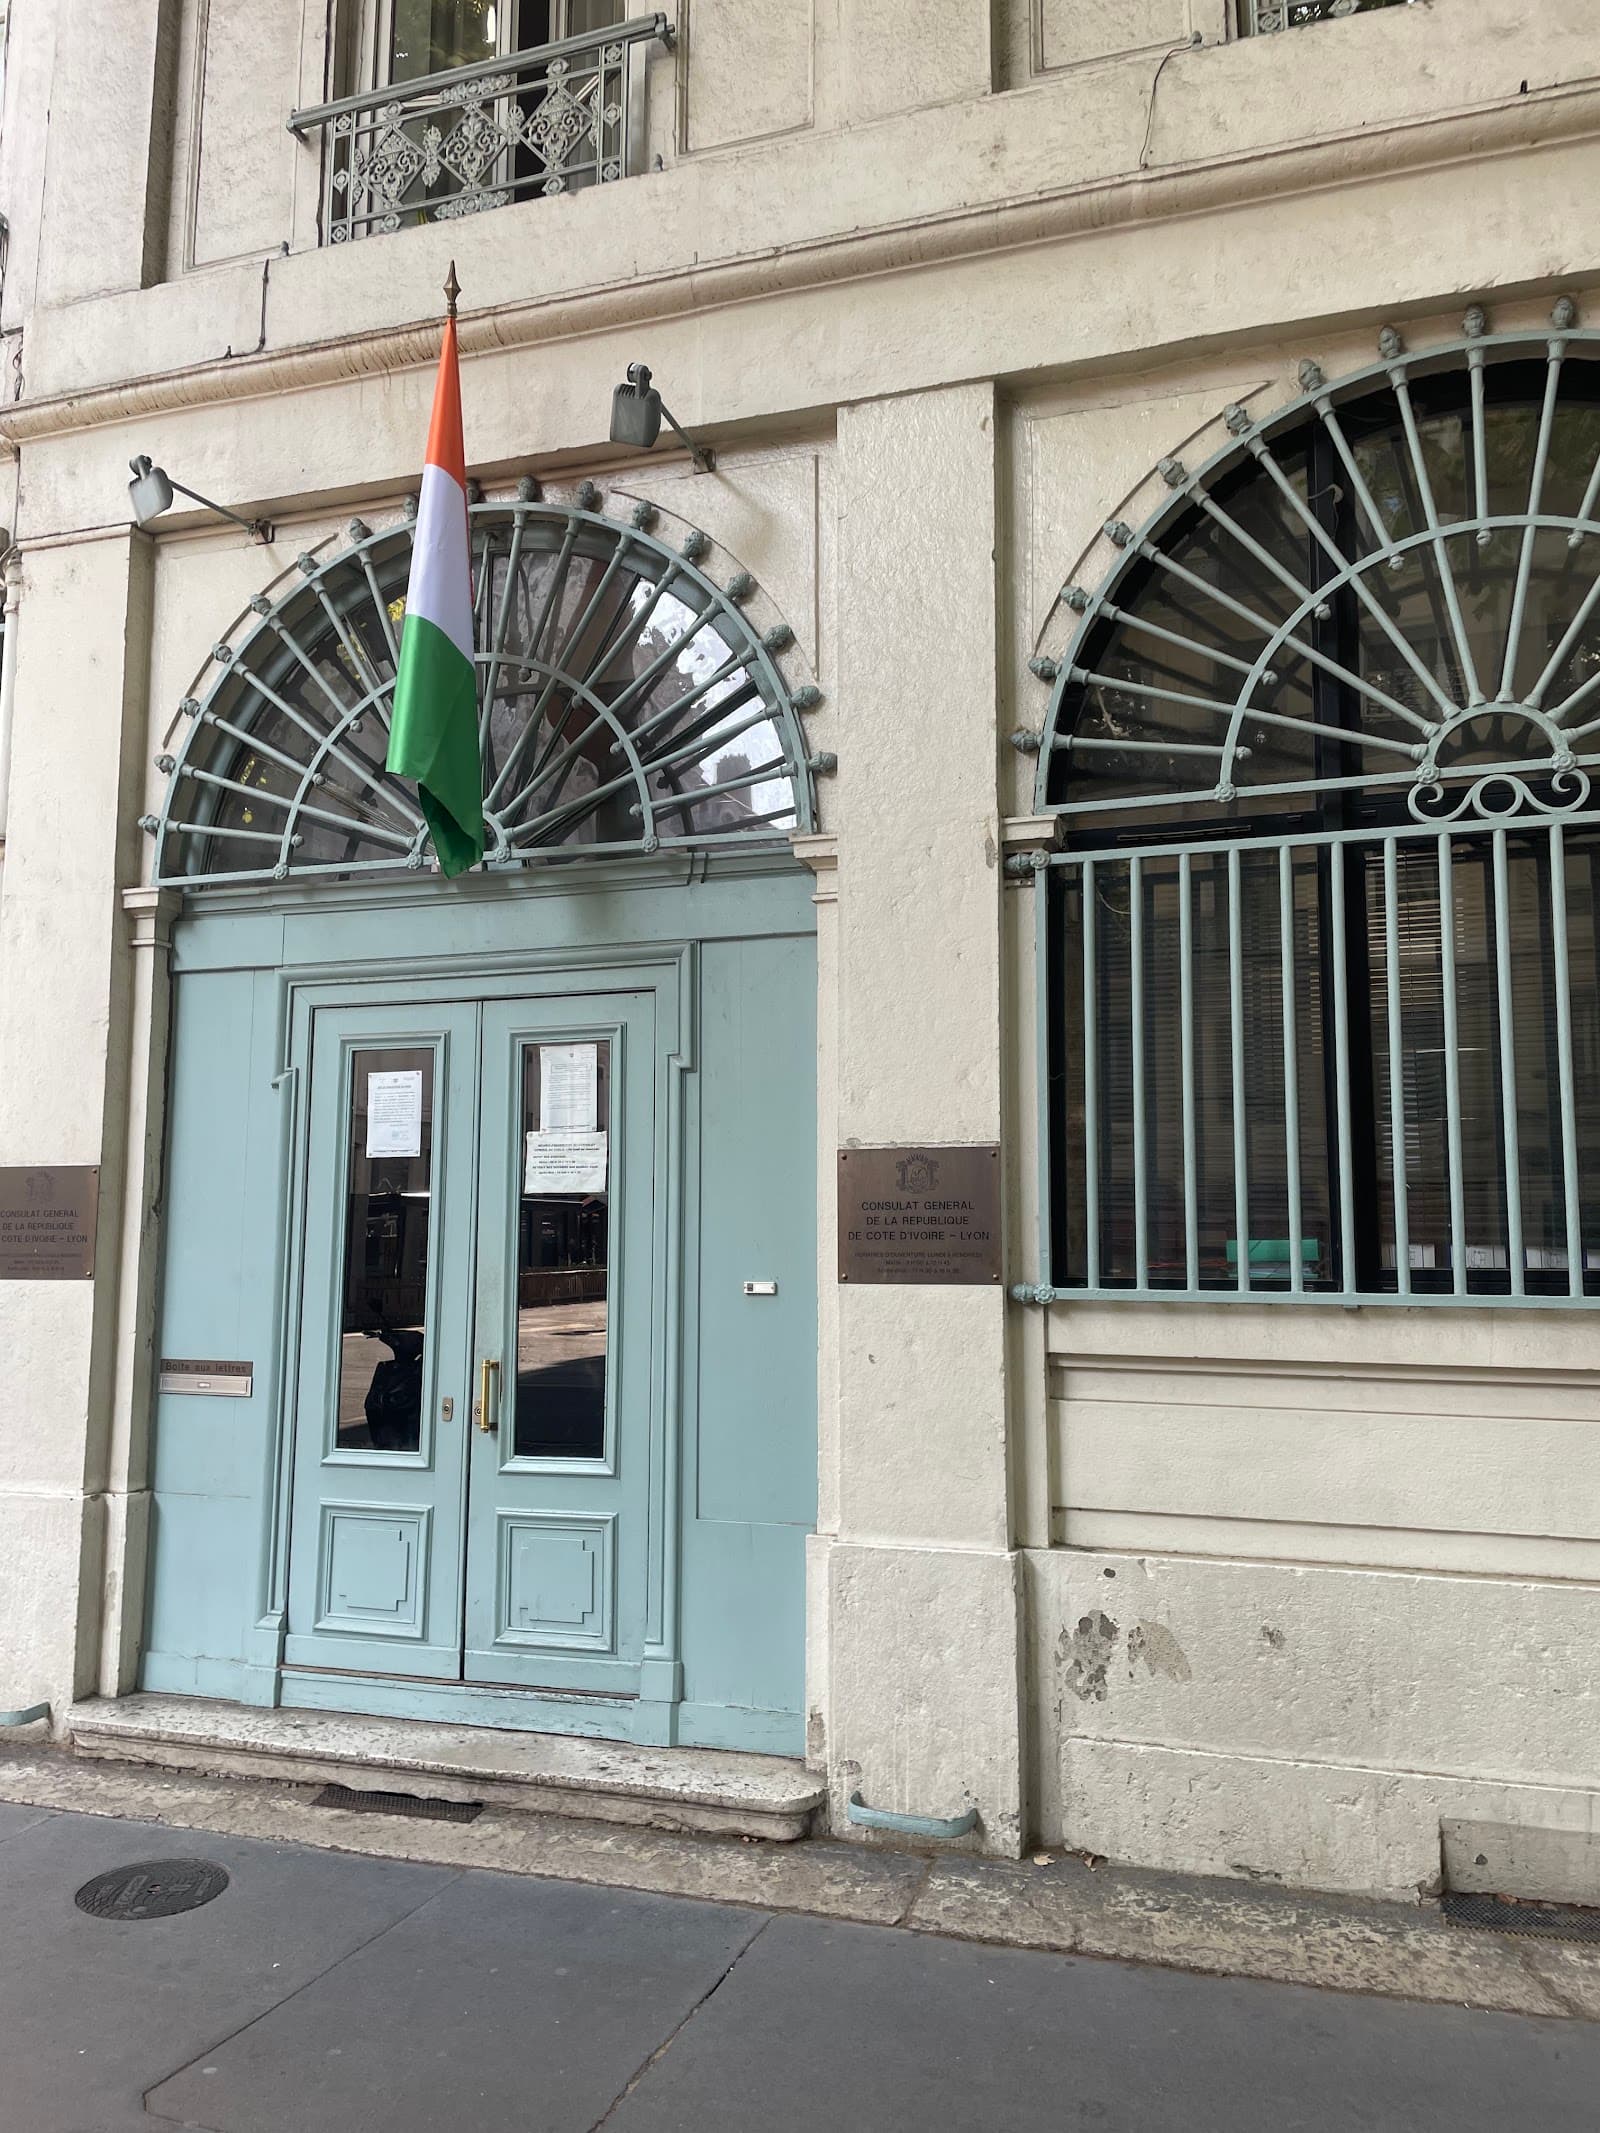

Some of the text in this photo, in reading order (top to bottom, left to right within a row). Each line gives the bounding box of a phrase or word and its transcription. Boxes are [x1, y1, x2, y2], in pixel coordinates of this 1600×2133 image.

[861, 1201, 975, 1211] CONSULAT GENERAL
[0, 1209, 79, 1218] CONSULAT GENERAL
[866, 1216, 969, 1225] DE LA REPUBLIQUE
[2, 1222, 13, 1231] DE
[15, 1222, 25, 1230] LA
[67, 1234, 88, 1243] LYON
[848, 1231, 862, 1241] DE
[866, 1231, 896, 1240] COTE
[899, 1231, 945, 1240] D'IVOIRE
[960, 1231, 990, 1241] LYON
